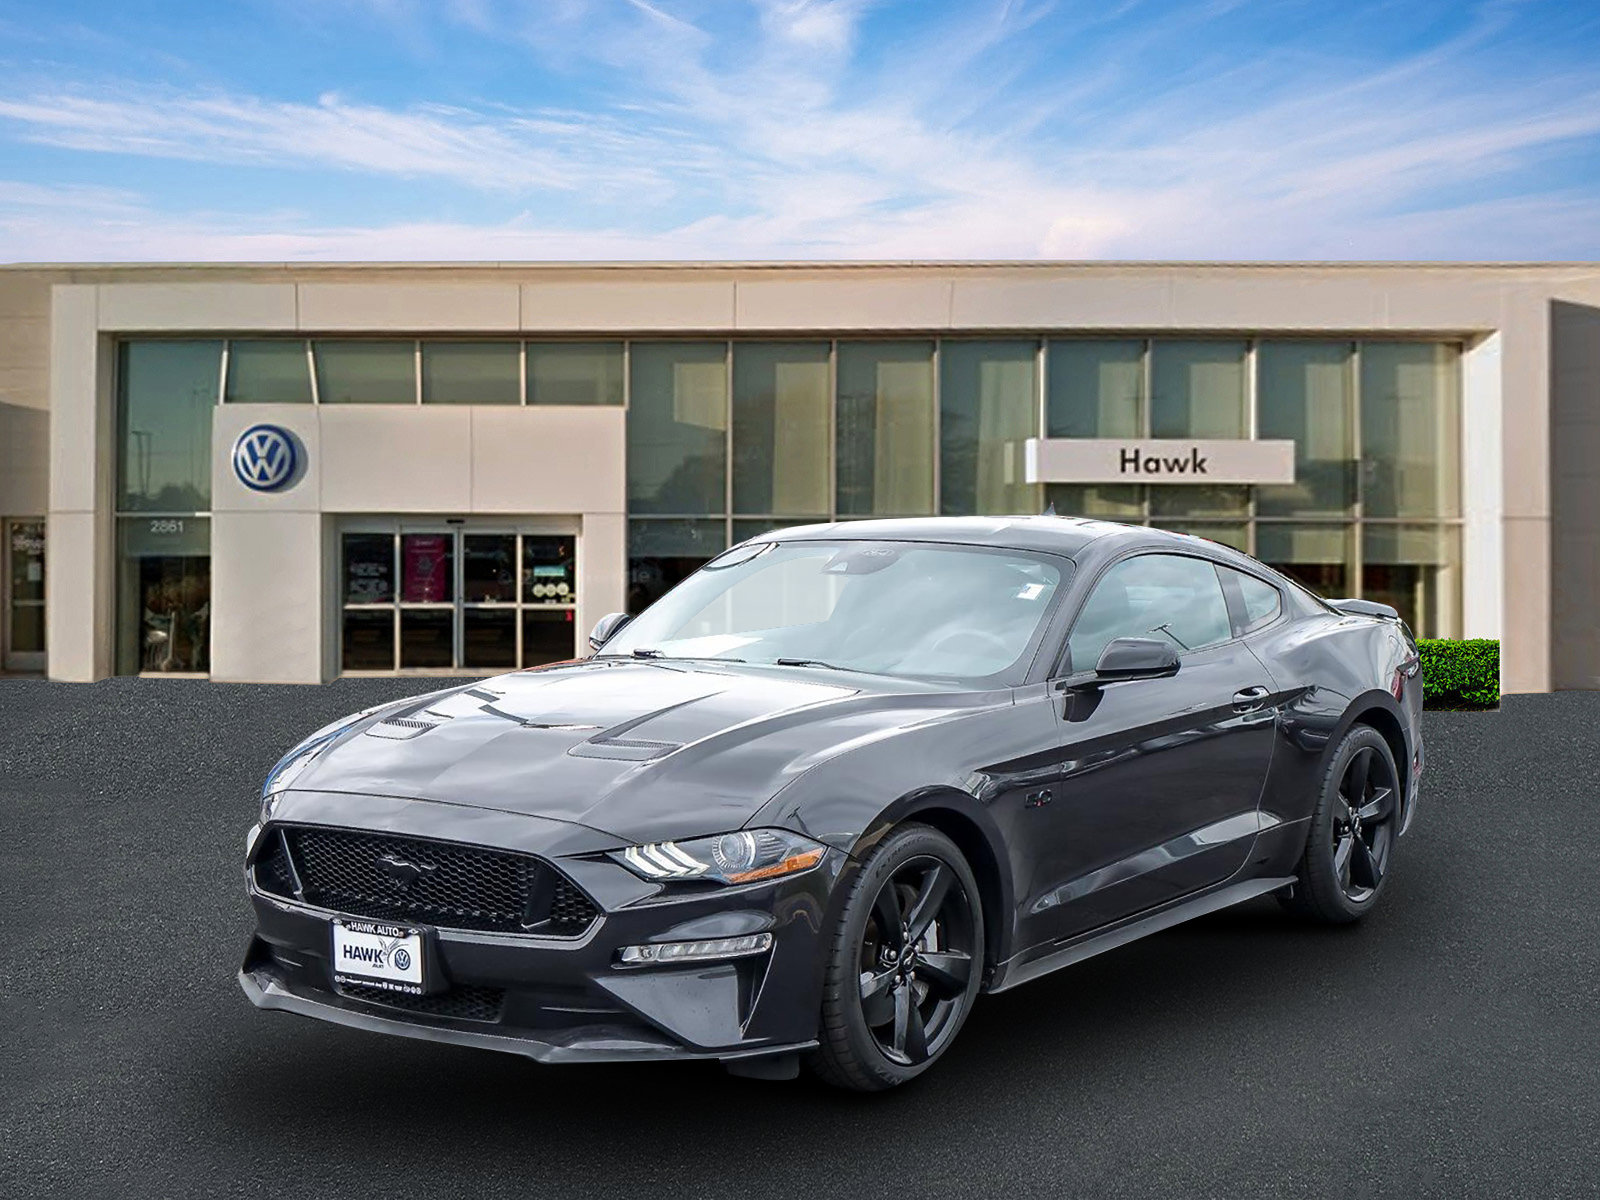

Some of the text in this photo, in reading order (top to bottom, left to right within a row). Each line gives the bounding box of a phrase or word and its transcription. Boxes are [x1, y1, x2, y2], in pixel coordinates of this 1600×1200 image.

[234, 427, 295, 491] VW
[1120, 447, 1207, 474] Hawk
[350, 921, 399, 937] HAWK AUTO
[343, 944, 383, 964] HAWK
